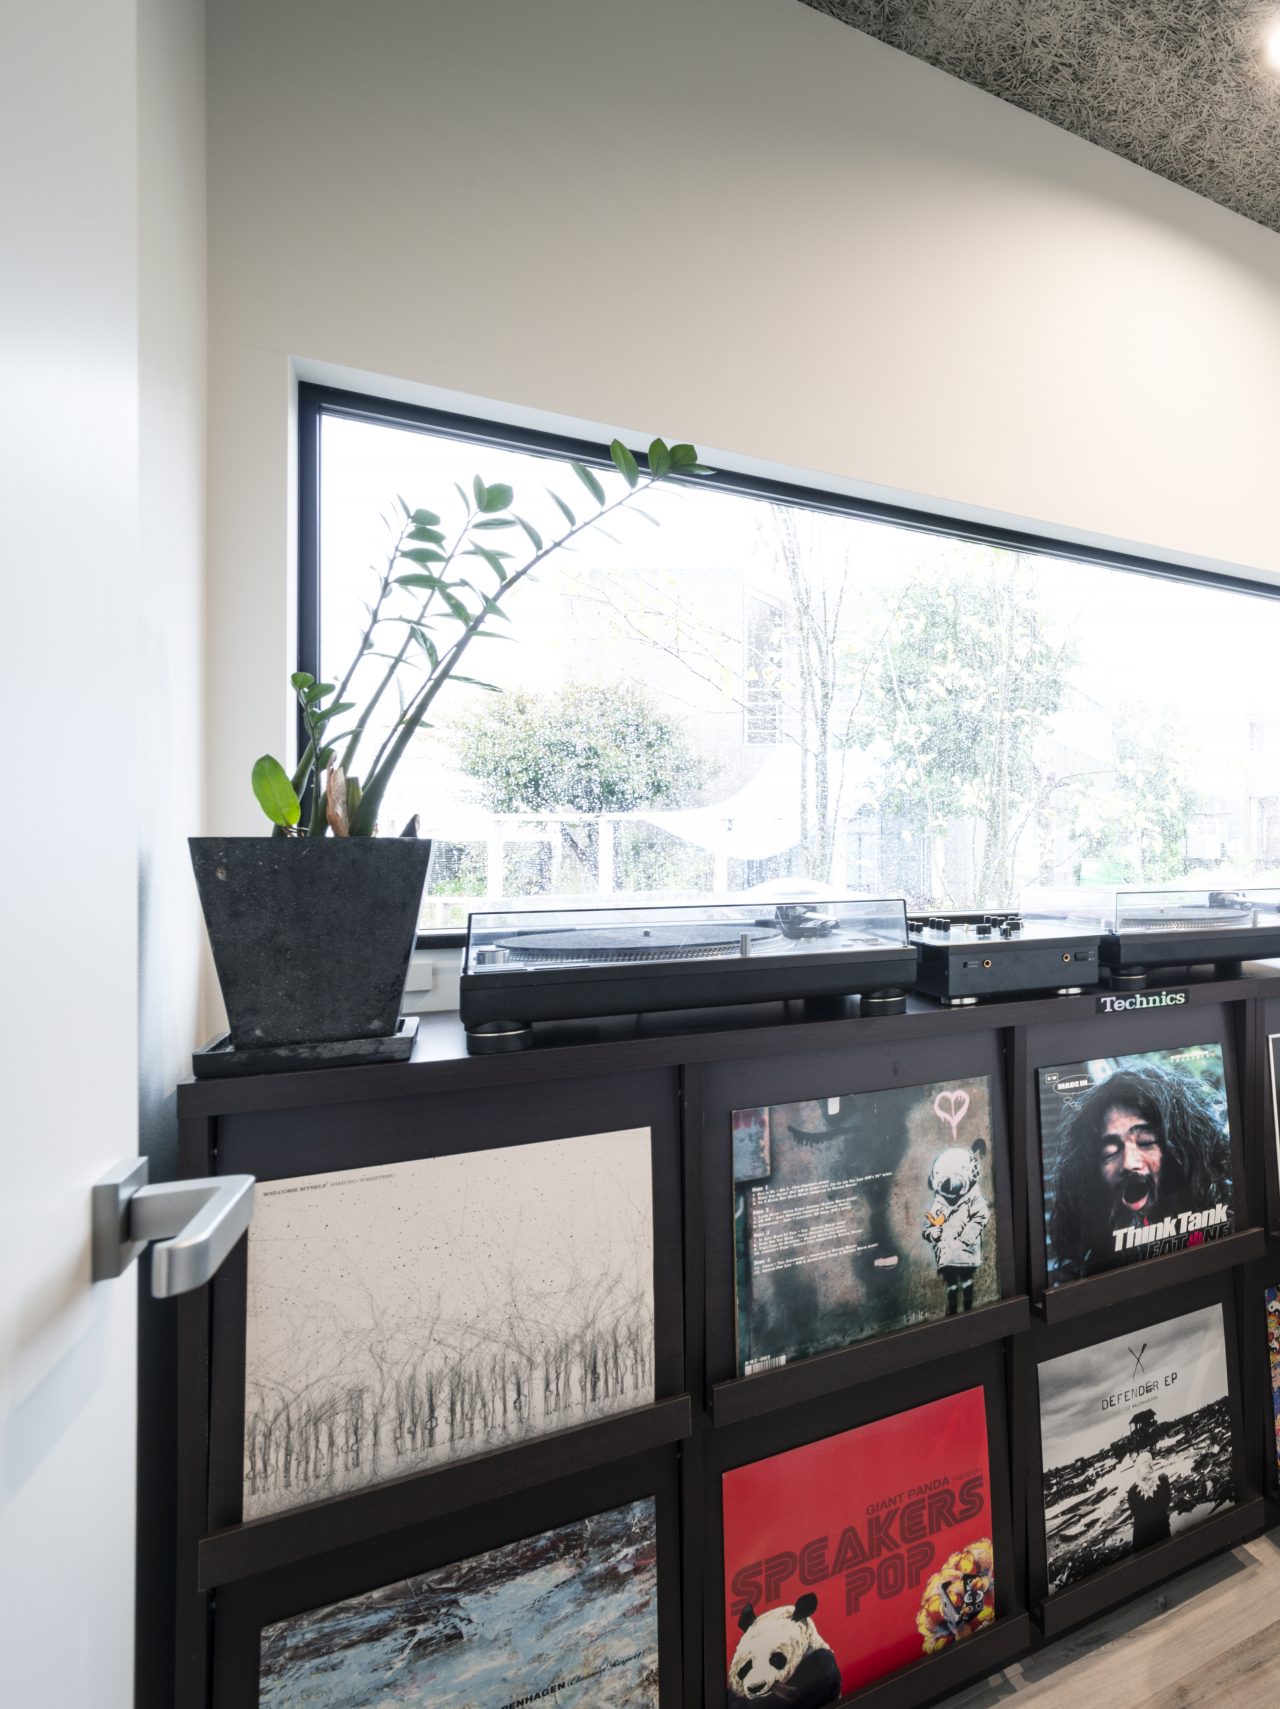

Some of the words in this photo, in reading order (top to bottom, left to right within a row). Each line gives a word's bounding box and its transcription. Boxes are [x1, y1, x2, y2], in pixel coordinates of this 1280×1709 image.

[1100, 991, 1185, 1012] Technics
[263, 1187, 298, 1197] WELCOME
[1101, 1380, 1159, 1411] DEFENDER
[1164, 1372, 1178, 1387] EP
[866, 1492, 905, 1516] GIANT
[908, 1476, 951, 1500] PANDA
[730, 1474, 985, 1617] SPEAKERS
[845, 1540, 936, 1617] POP
